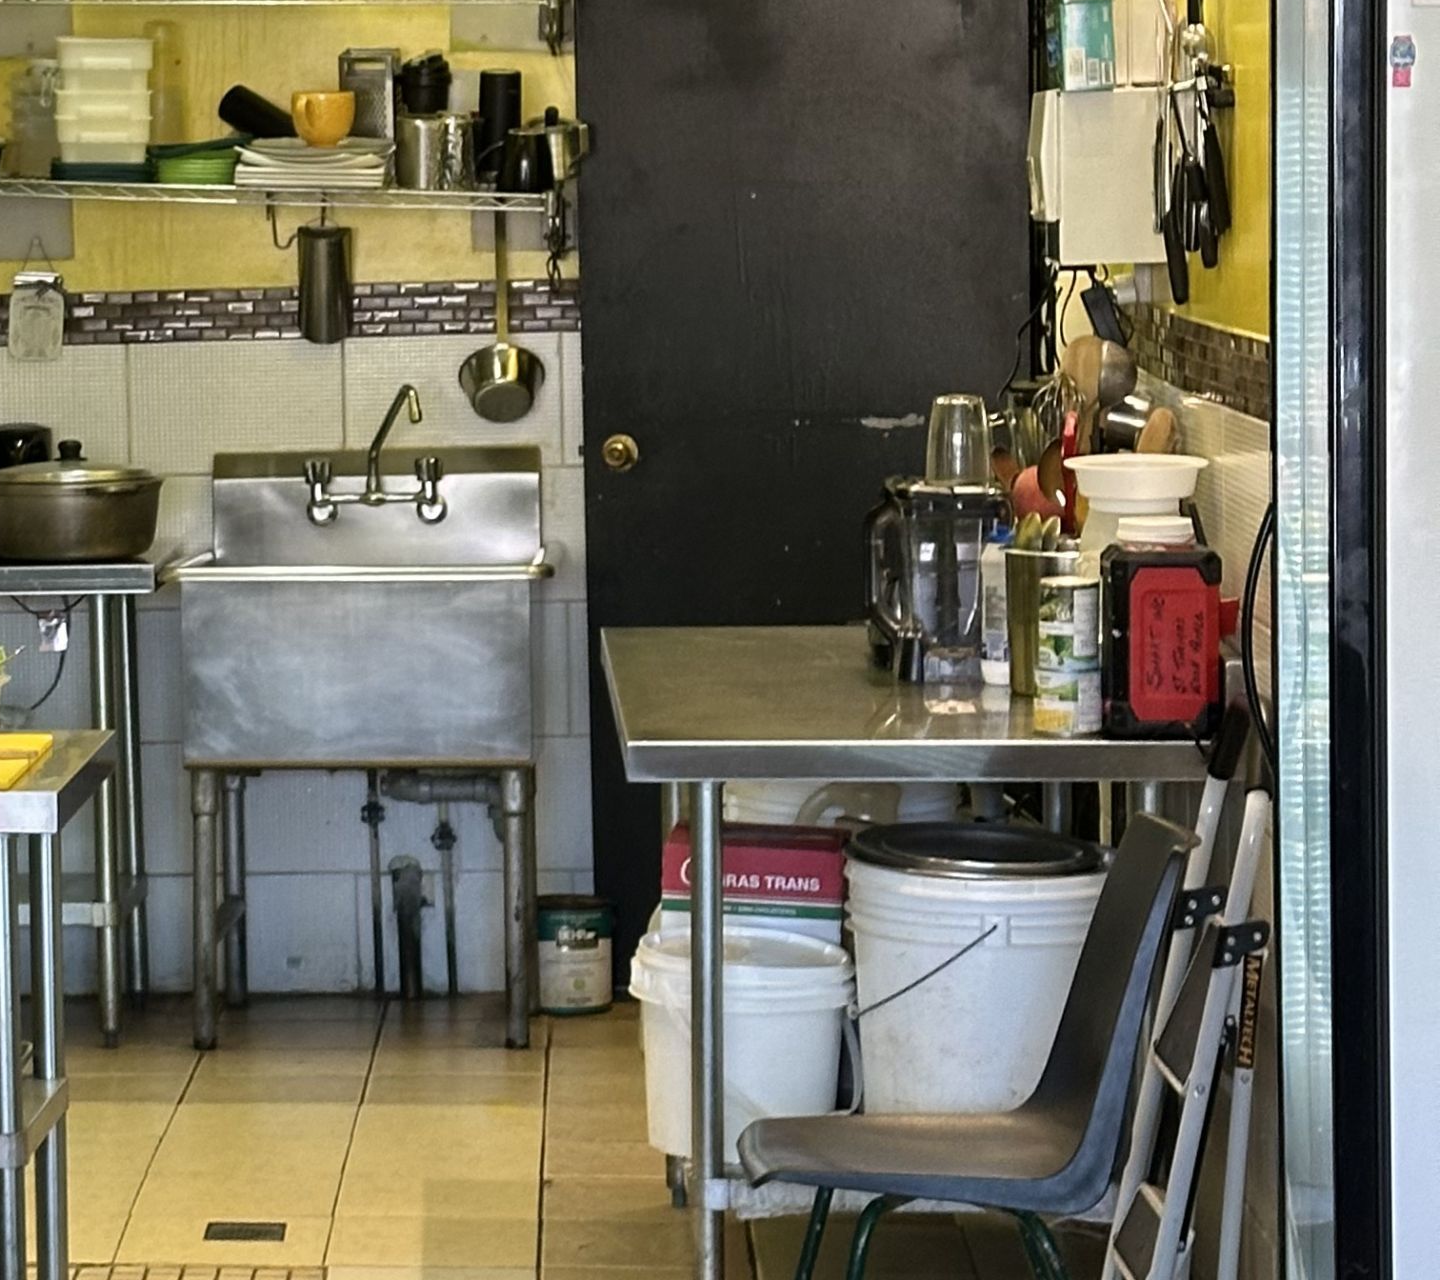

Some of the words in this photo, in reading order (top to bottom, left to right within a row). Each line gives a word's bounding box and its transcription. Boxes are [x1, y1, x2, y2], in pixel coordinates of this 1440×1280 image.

[723, 872, 760, 888] RAS
[764, 874, 821, 892] TRANS
[1238, 957, 1262, 1066] METALTECH
